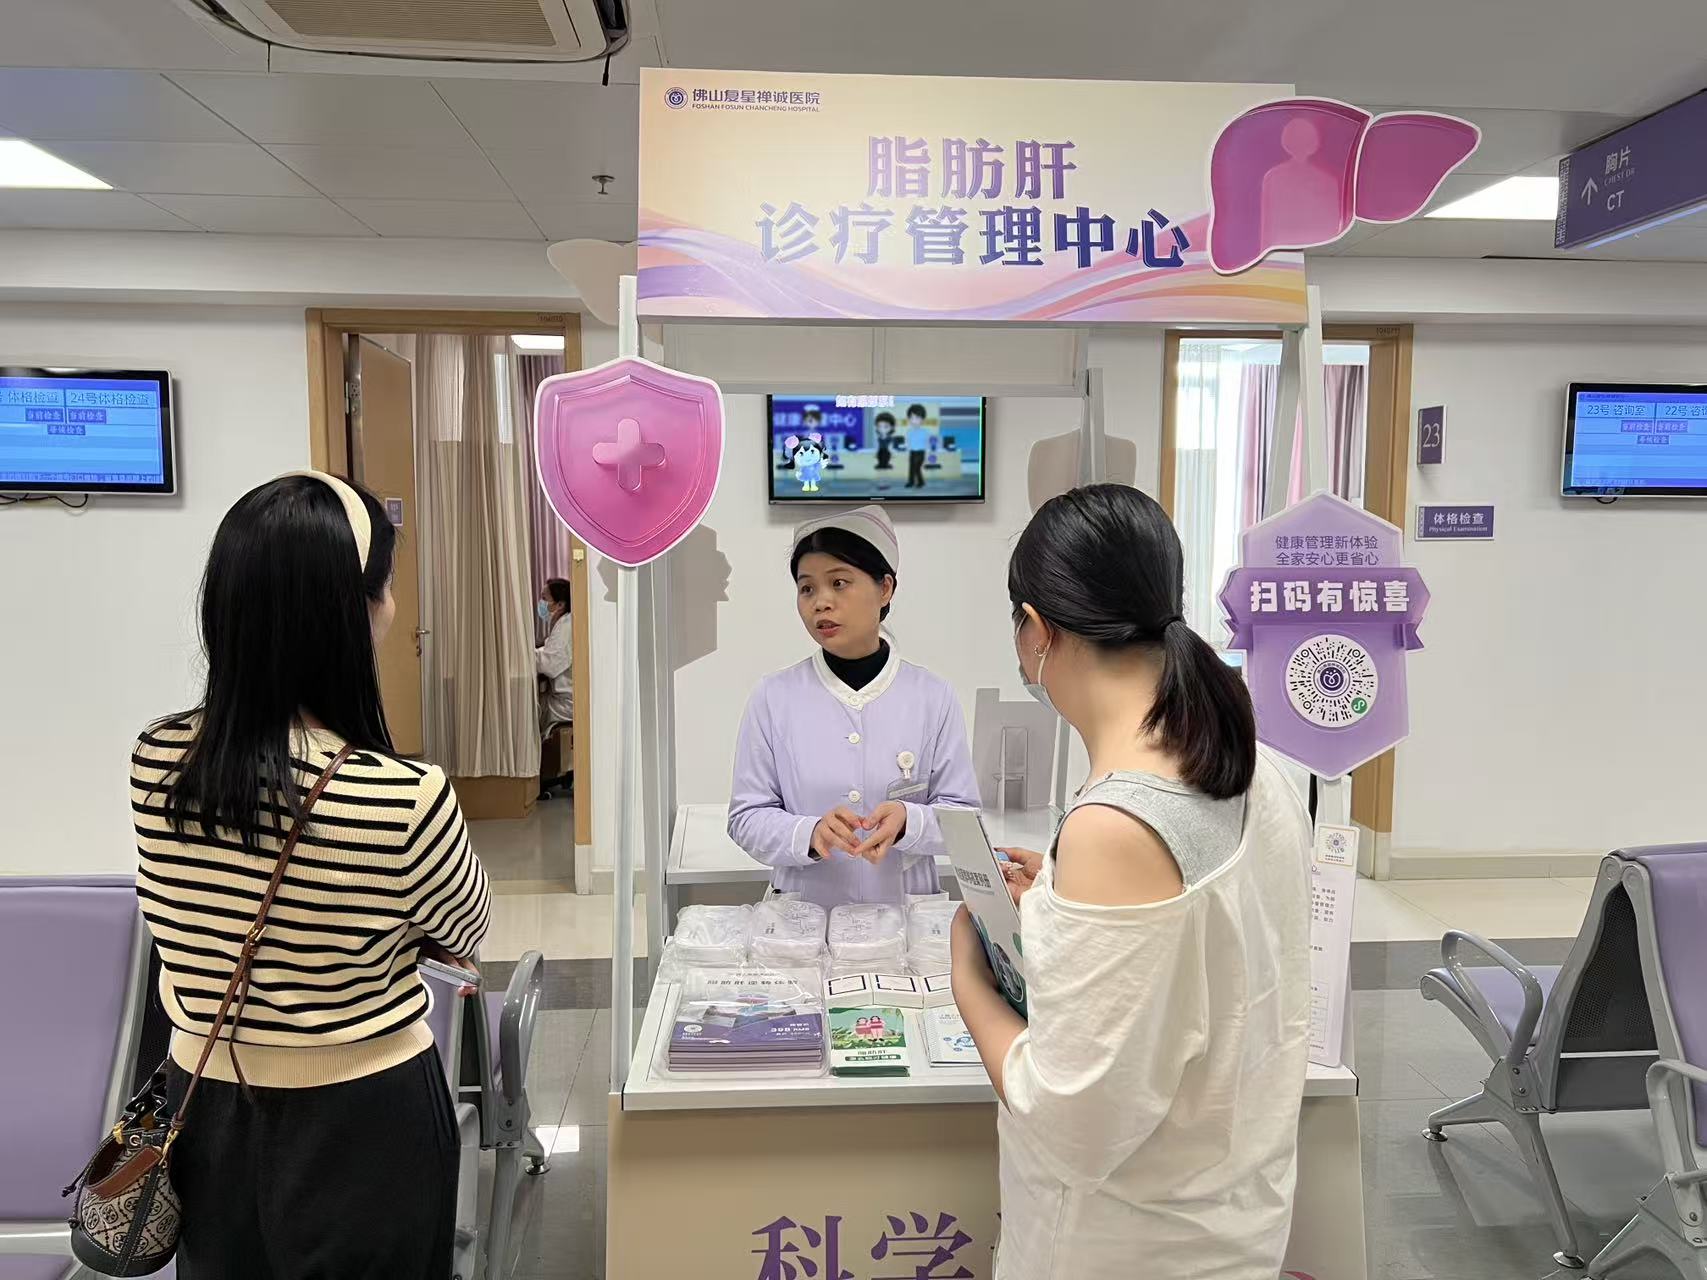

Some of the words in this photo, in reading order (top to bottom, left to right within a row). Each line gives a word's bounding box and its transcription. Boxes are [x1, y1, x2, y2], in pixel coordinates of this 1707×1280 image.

[692, 88, 820, 105] 佛山复星禅诚医院
[866, 135, 1077, 200] 脂肪肝
[1605, 145, 1631, 174] 胸片
[1607, 190, 1625, 211] CT
[755, 200, 1192, 270] 诊疗管理中心
[1587, 405, 1610, 416] 23号
[1423, 423, 1440, 448] 23
[1433, 512, 1484, 525] 体格检查
[1275, 535, 1378, 550] 健康管理新体验
[1276, 551, 1379, 566] 全家安心更省心
[1250, 580, 1410, 613] 扫码有惊喜
